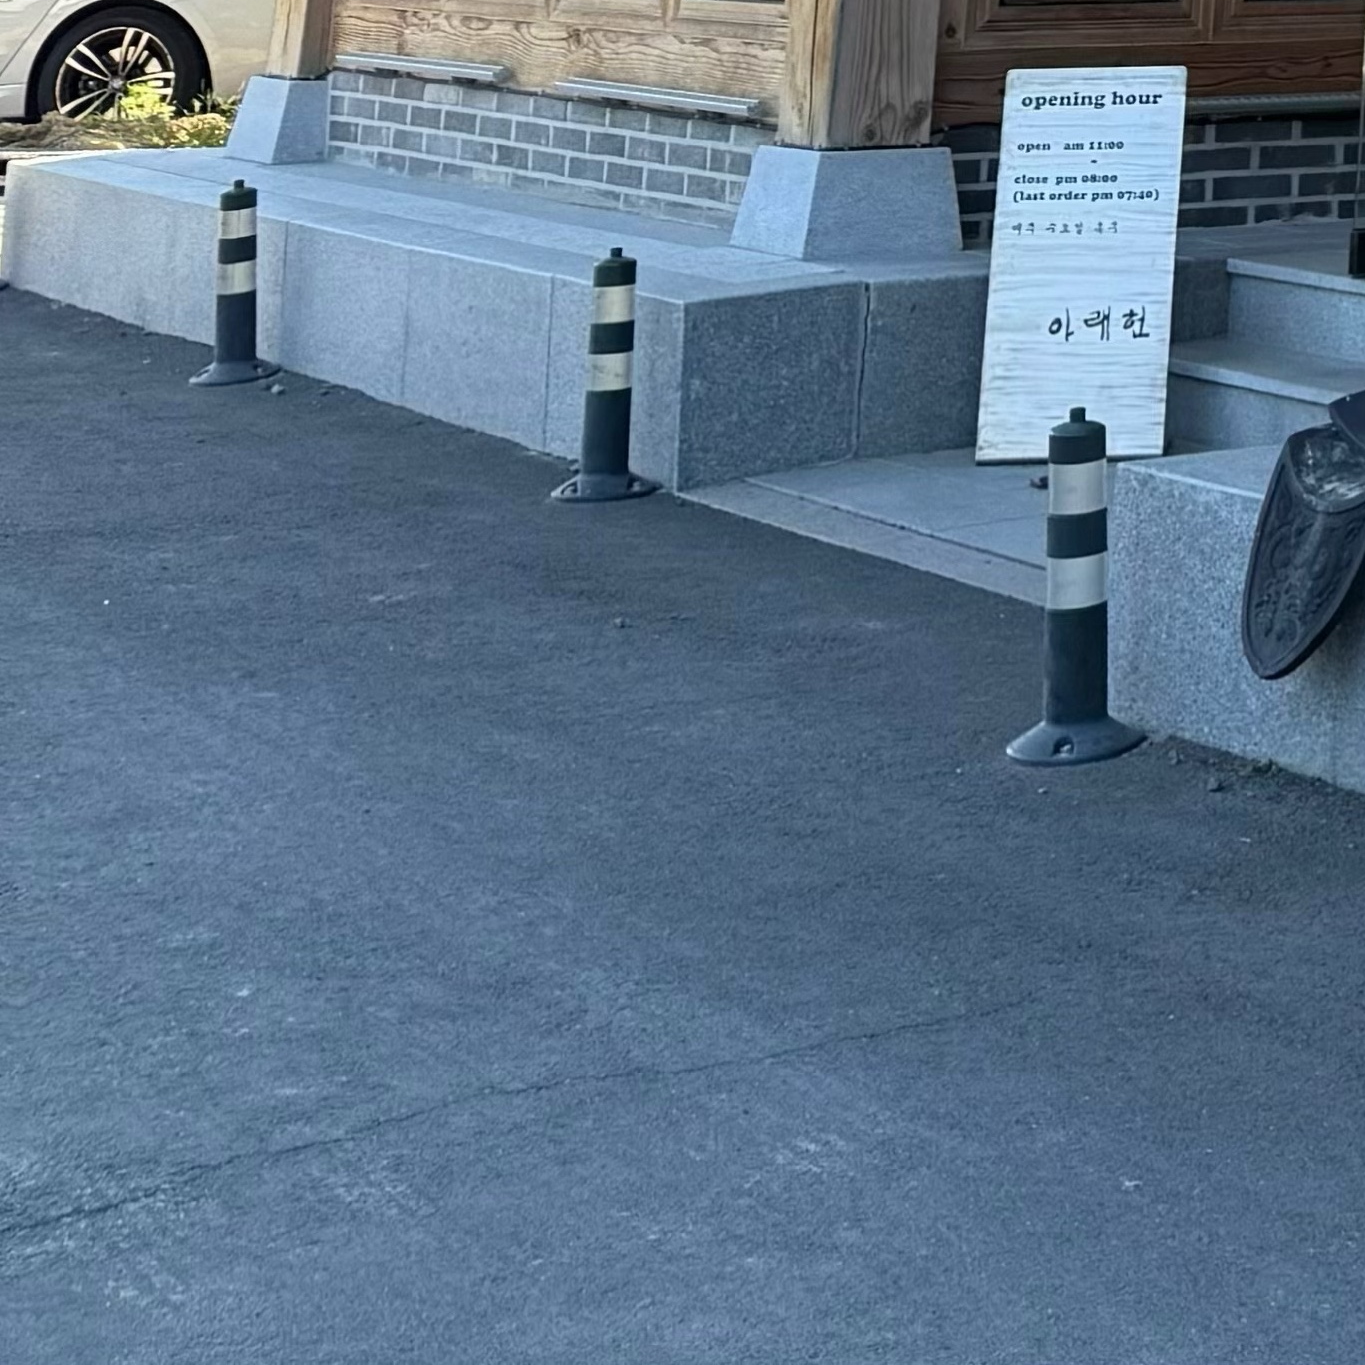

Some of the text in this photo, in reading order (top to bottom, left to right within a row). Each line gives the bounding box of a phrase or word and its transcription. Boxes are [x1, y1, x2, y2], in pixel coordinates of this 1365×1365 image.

[1021, 91, 1163, 109] opening hour
[1017, 141, 1124, 152] open am 11:00
[1014, 174, 1048, 184] close
[1055, 176, 1077, 185] pm
[1013, 191, 1045, 203] (last
[1049, 191, 1087, 200] order
[1091, 192, 1113, 202] pm
